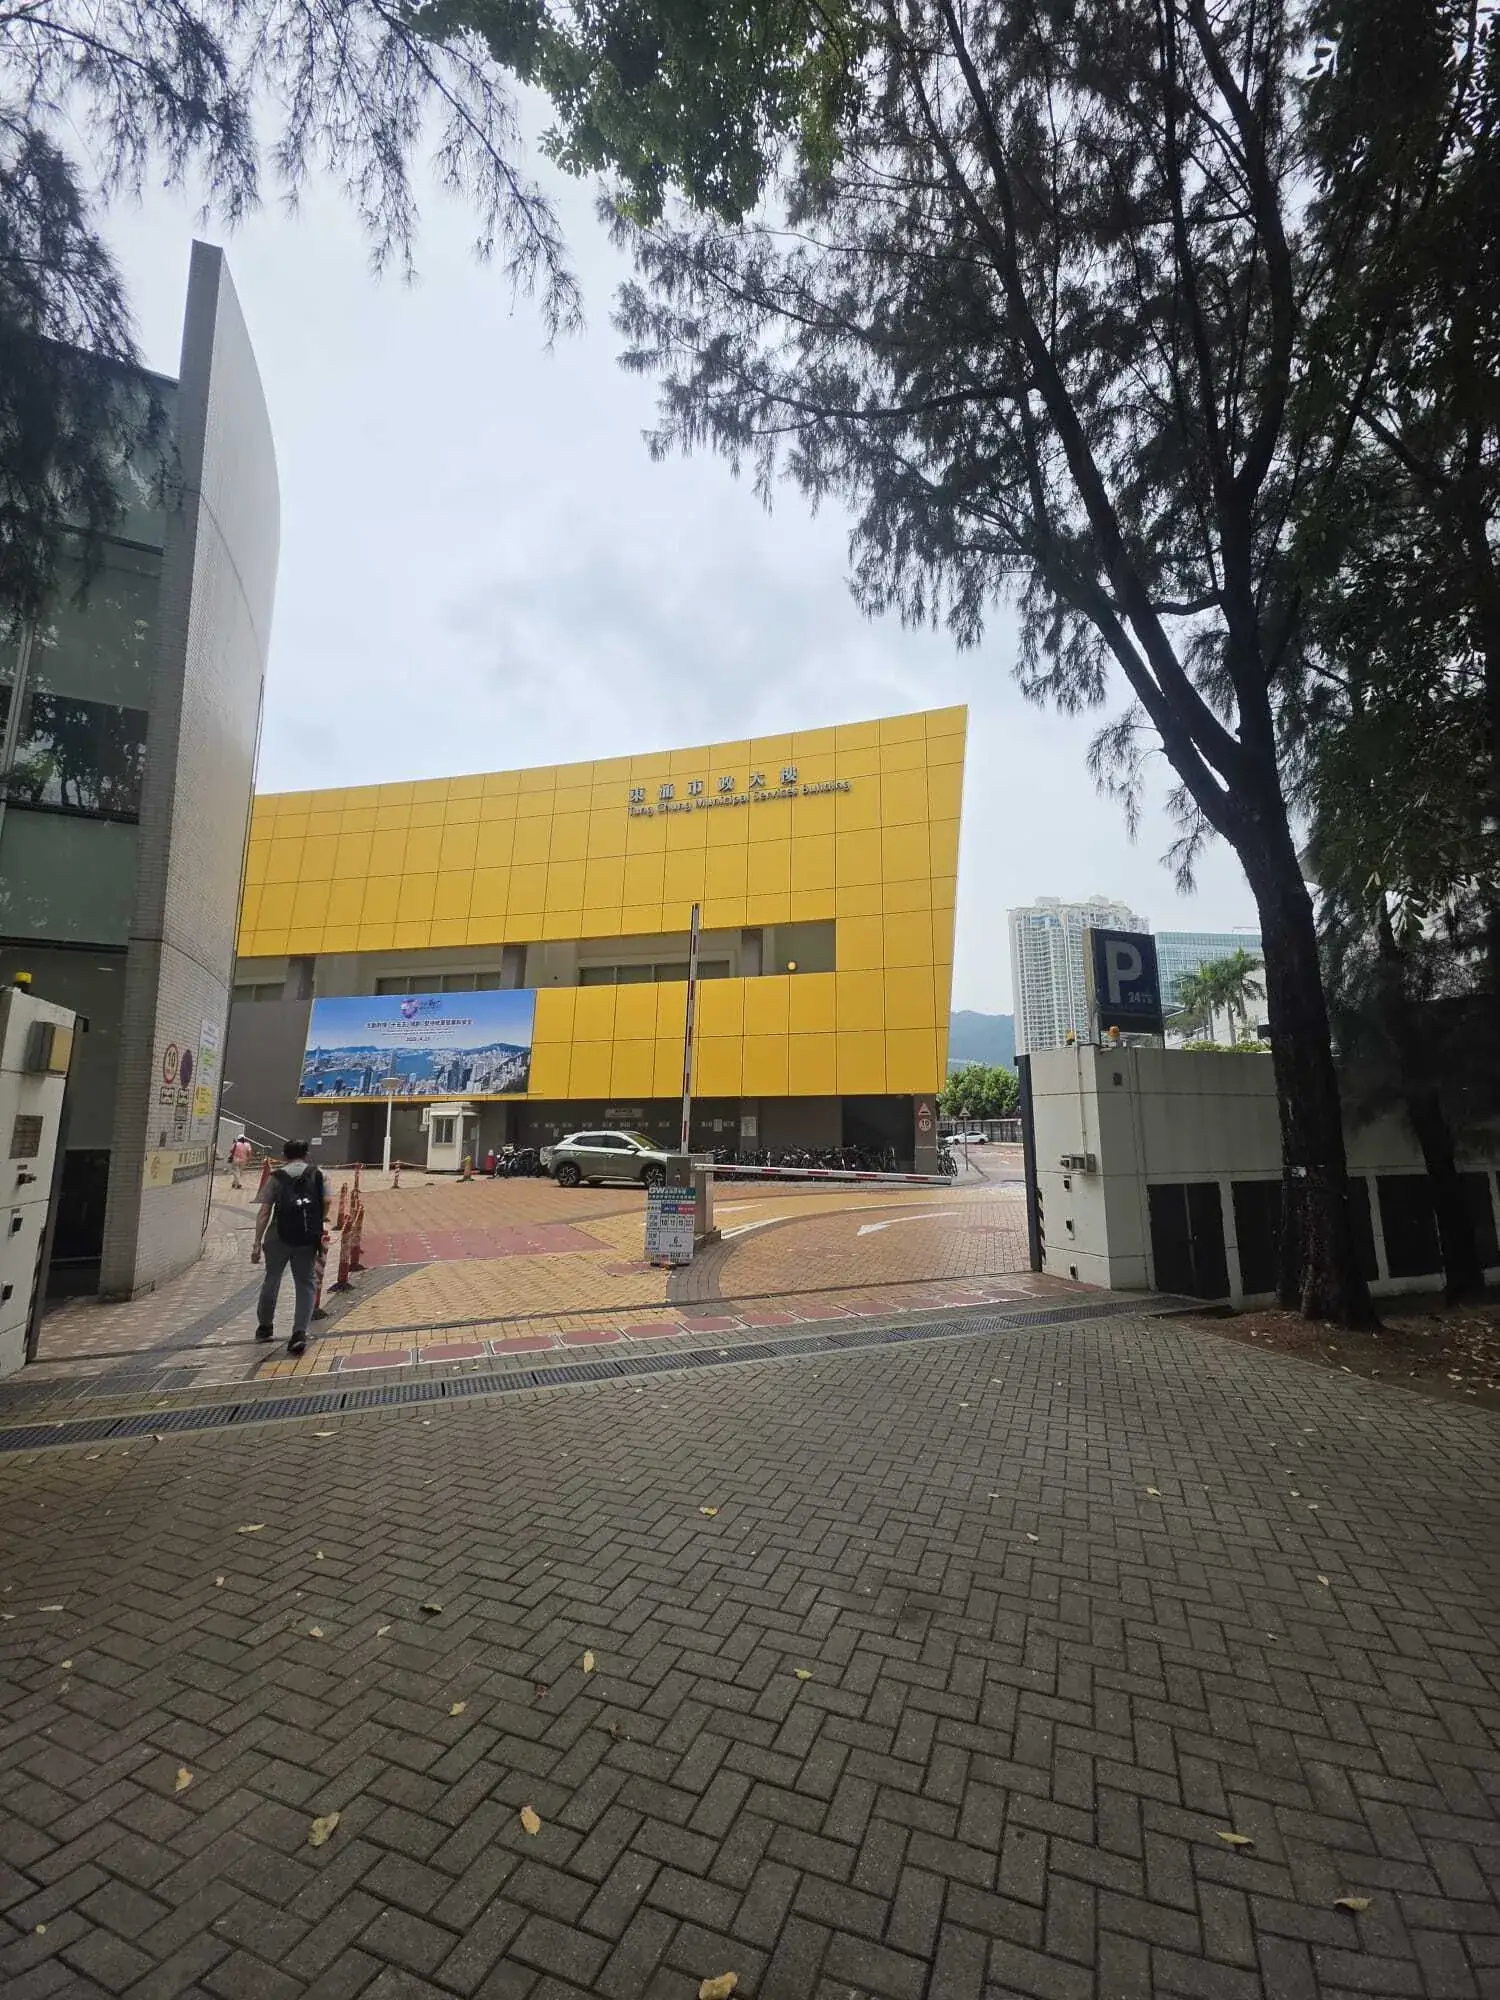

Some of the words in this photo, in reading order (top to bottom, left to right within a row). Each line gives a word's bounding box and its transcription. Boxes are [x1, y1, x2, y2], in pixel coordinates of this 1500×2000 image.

[628, 806, 655, 818] Tung
[657, 802, 692, 816] Chung
[696, 793, 749, 809] Municipal
[753, 787, 798, 802] Services
[802, 780, 851, 796] Building
[630, 767, 798, 803] 東涌市政大樓
[1105, 940, 1143, 1004] P
